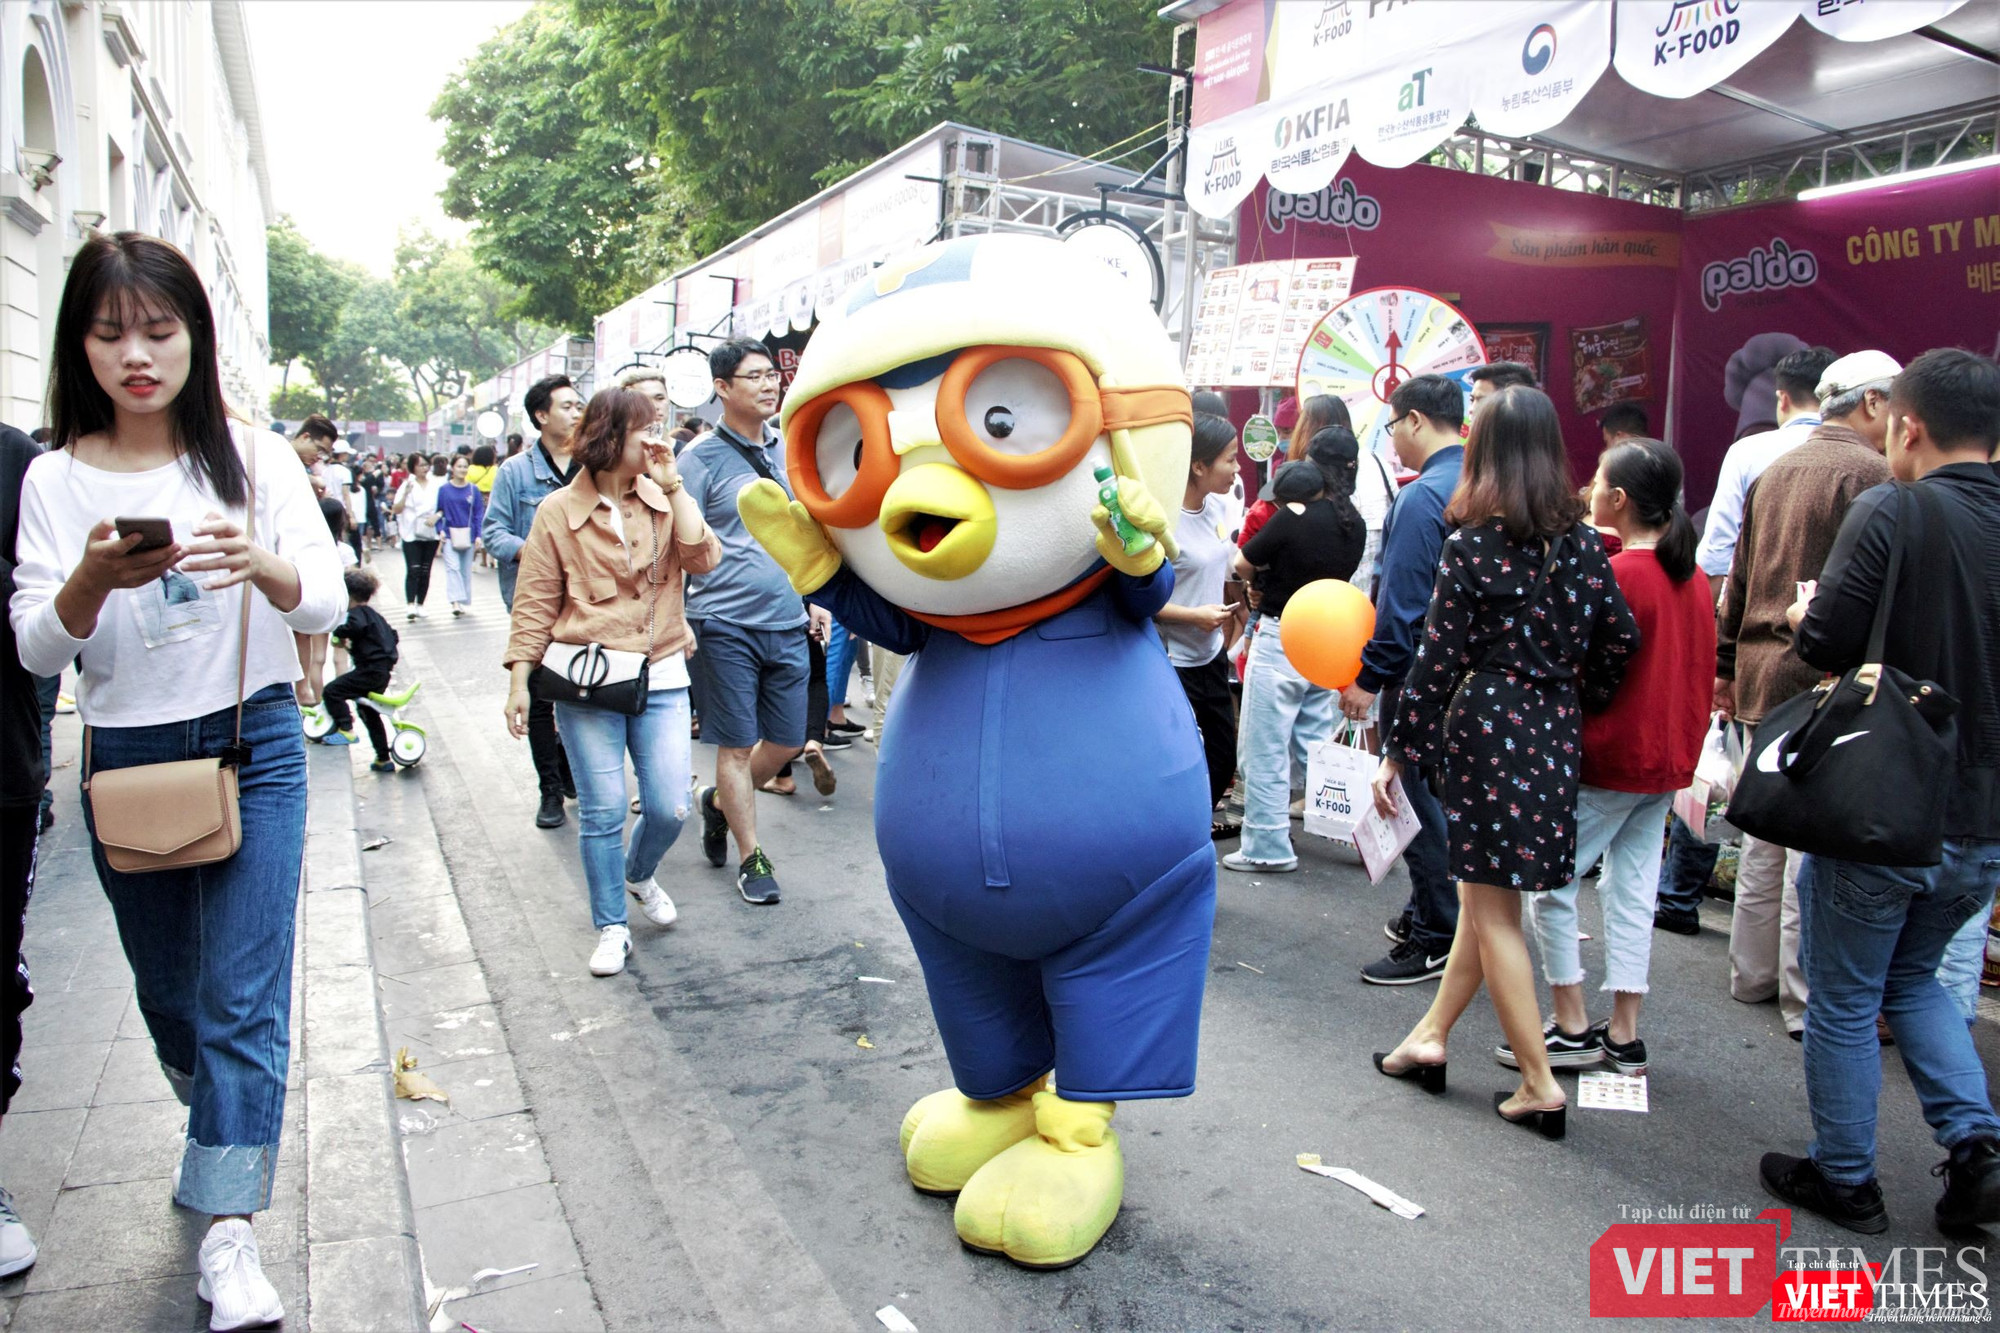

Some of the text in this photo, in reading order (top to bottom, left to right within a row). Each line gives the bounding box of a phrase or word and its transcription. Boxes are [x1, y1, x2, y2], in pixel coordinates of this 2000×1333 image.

[1313, 19, 1352, 47] K-FOOD
[1653, 18, 1741, 67] K-FOOD
[1501, 78, 1573, 112] 농림축산식품부
[1295, 98, 1351, 142] KFIA
[1204, 170, 1242, 195] K-FOOD
[1267, 178, 1381, 233] paldo
[1846, 226, 1920, 266] CÔNG
[1927, 219, 1964, 254] TY
[1702, 237, 1818, 312] paldo
[1315, 797, 1351, 815] K-FOOD
